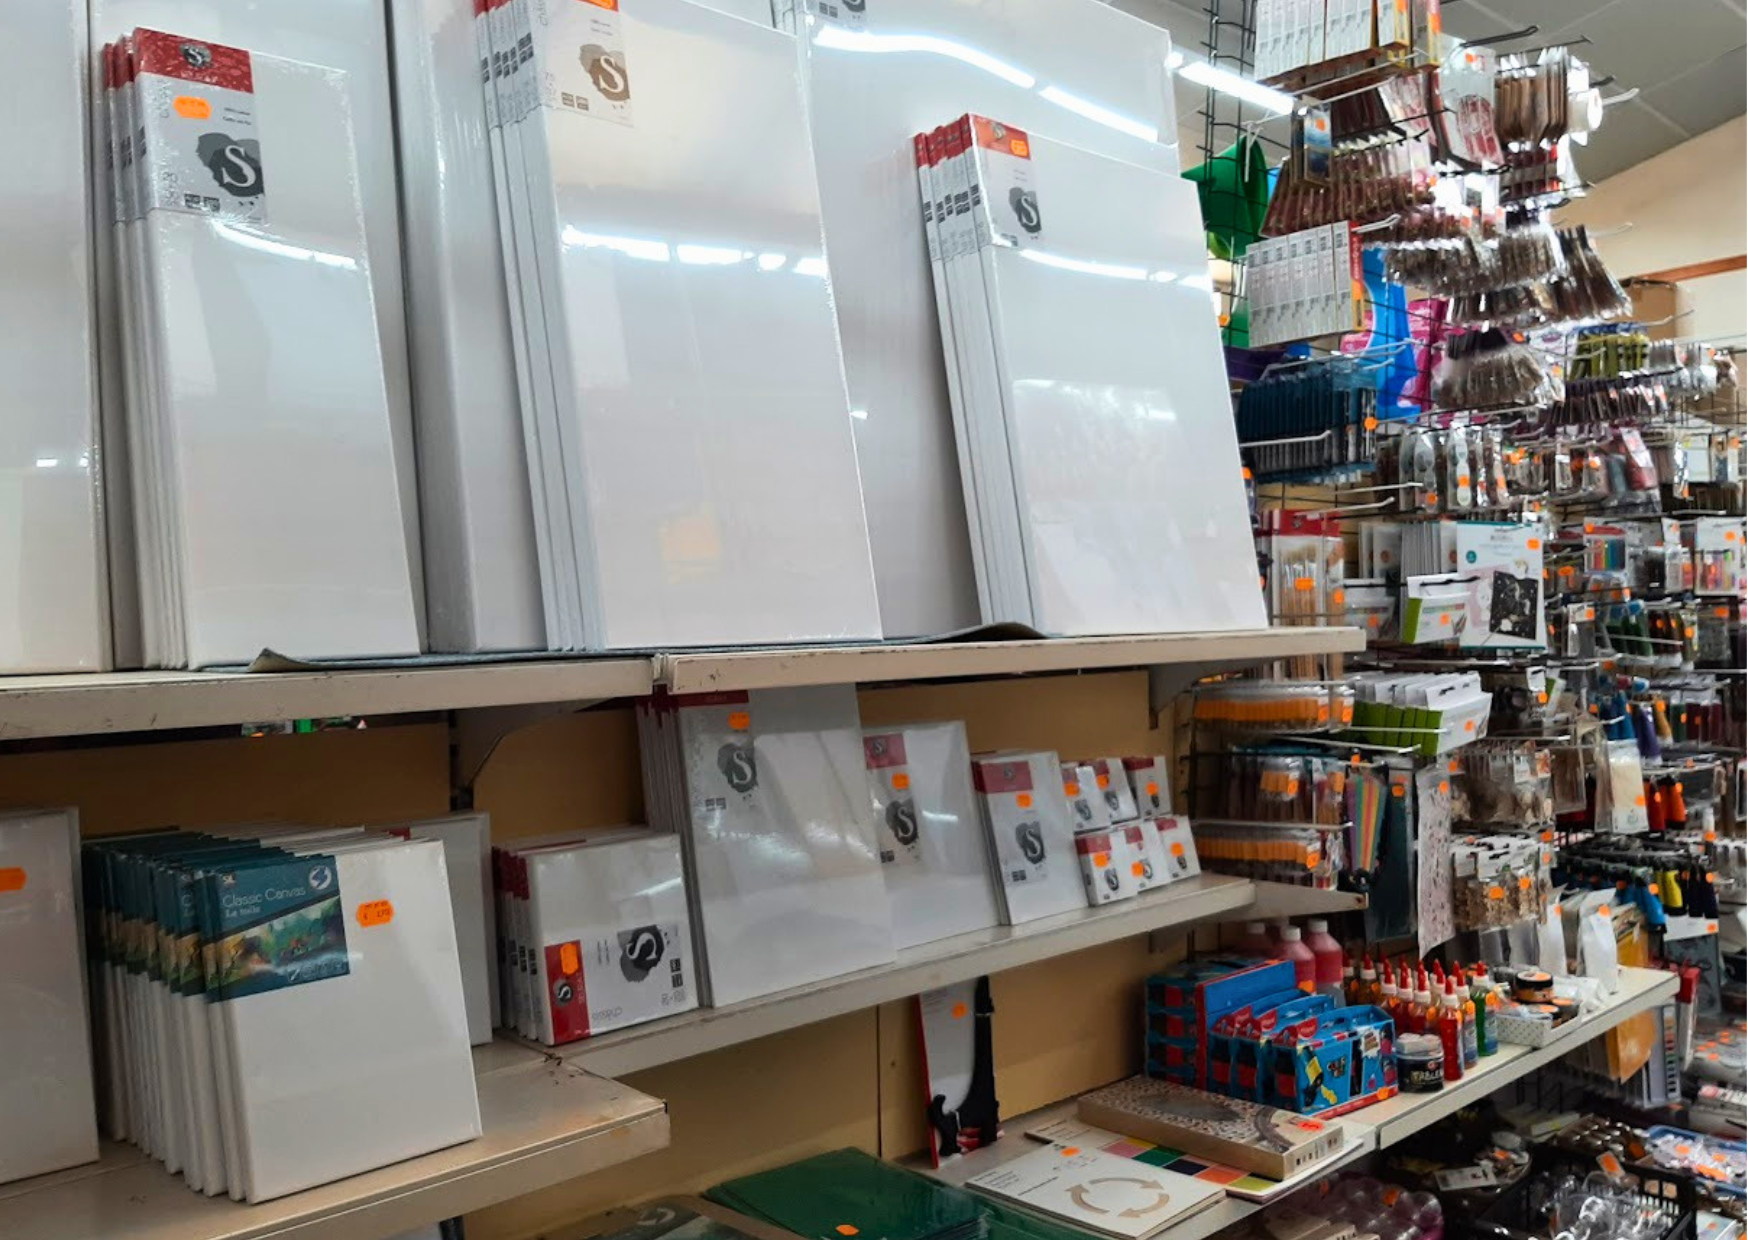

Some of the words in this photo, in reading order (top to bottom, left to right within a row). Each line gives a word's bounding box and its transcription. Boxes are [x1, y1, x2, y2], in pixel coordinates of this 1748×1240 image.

[599, 56, 625, 93] S
[222, 145, 256, 187] S
[1021, 195, 1038, 226] S
[733, 750, 752, 784] S
[897, 806, 914, 838] S
[1026, 828, 1041, 858] S
[223, 892, 263, 908] Classic
[265, 886, 307, 901] Canvas
[626, 932, 657, 960] S
